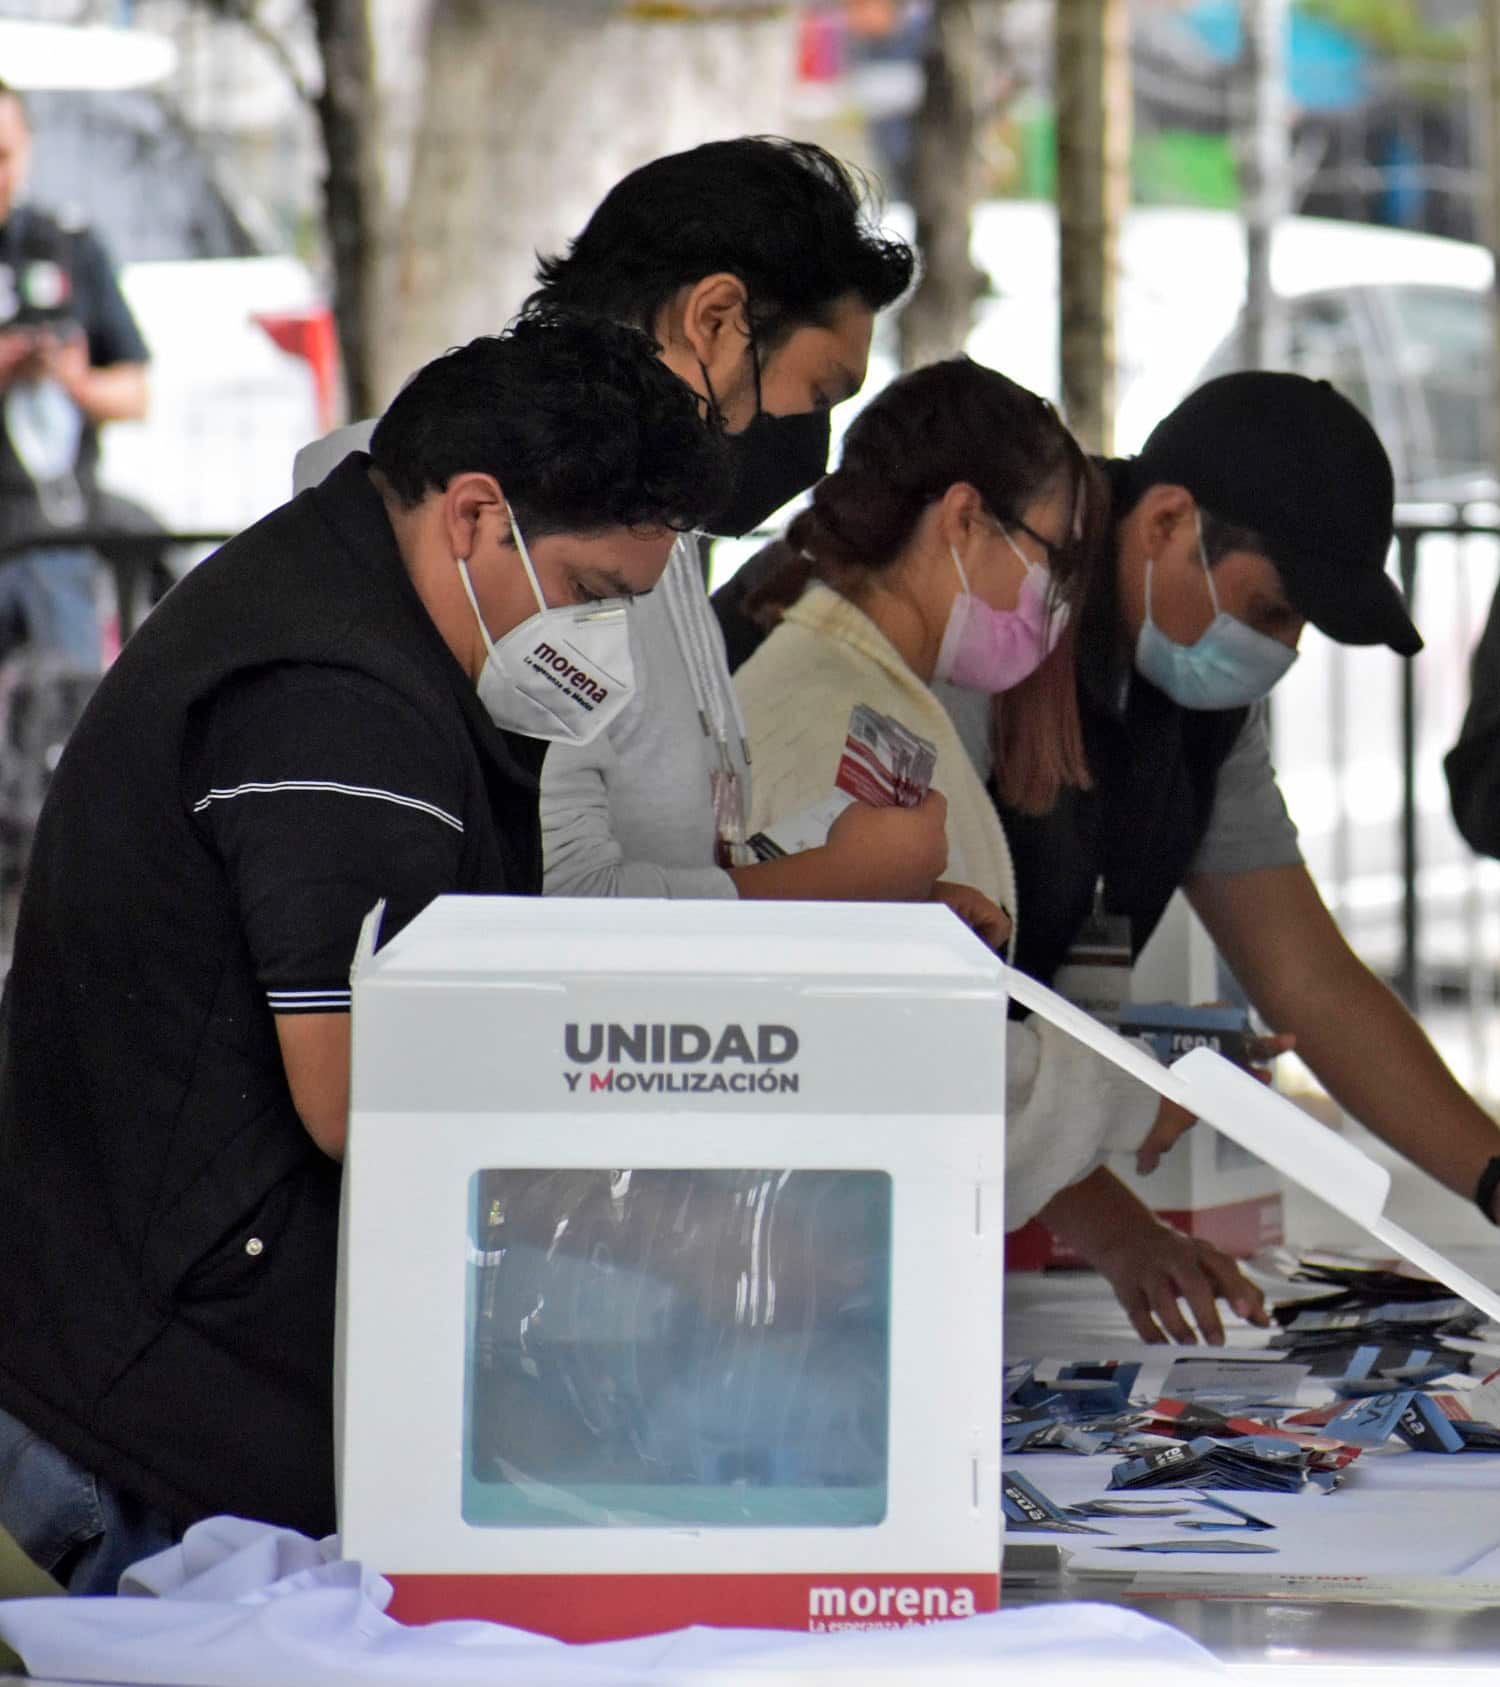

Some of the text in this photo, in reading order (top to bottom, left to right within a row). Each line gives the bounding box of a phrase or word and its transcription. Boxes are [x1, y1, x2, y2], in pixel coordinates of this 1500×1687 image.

[533, 642, 608, 704] morena
[564, 1023, 799, 1064] UNIDAD
[563, 1067, 799, 1093] Y MOVILIZACIÓN
[809, 1587, 976, 1617] morena
